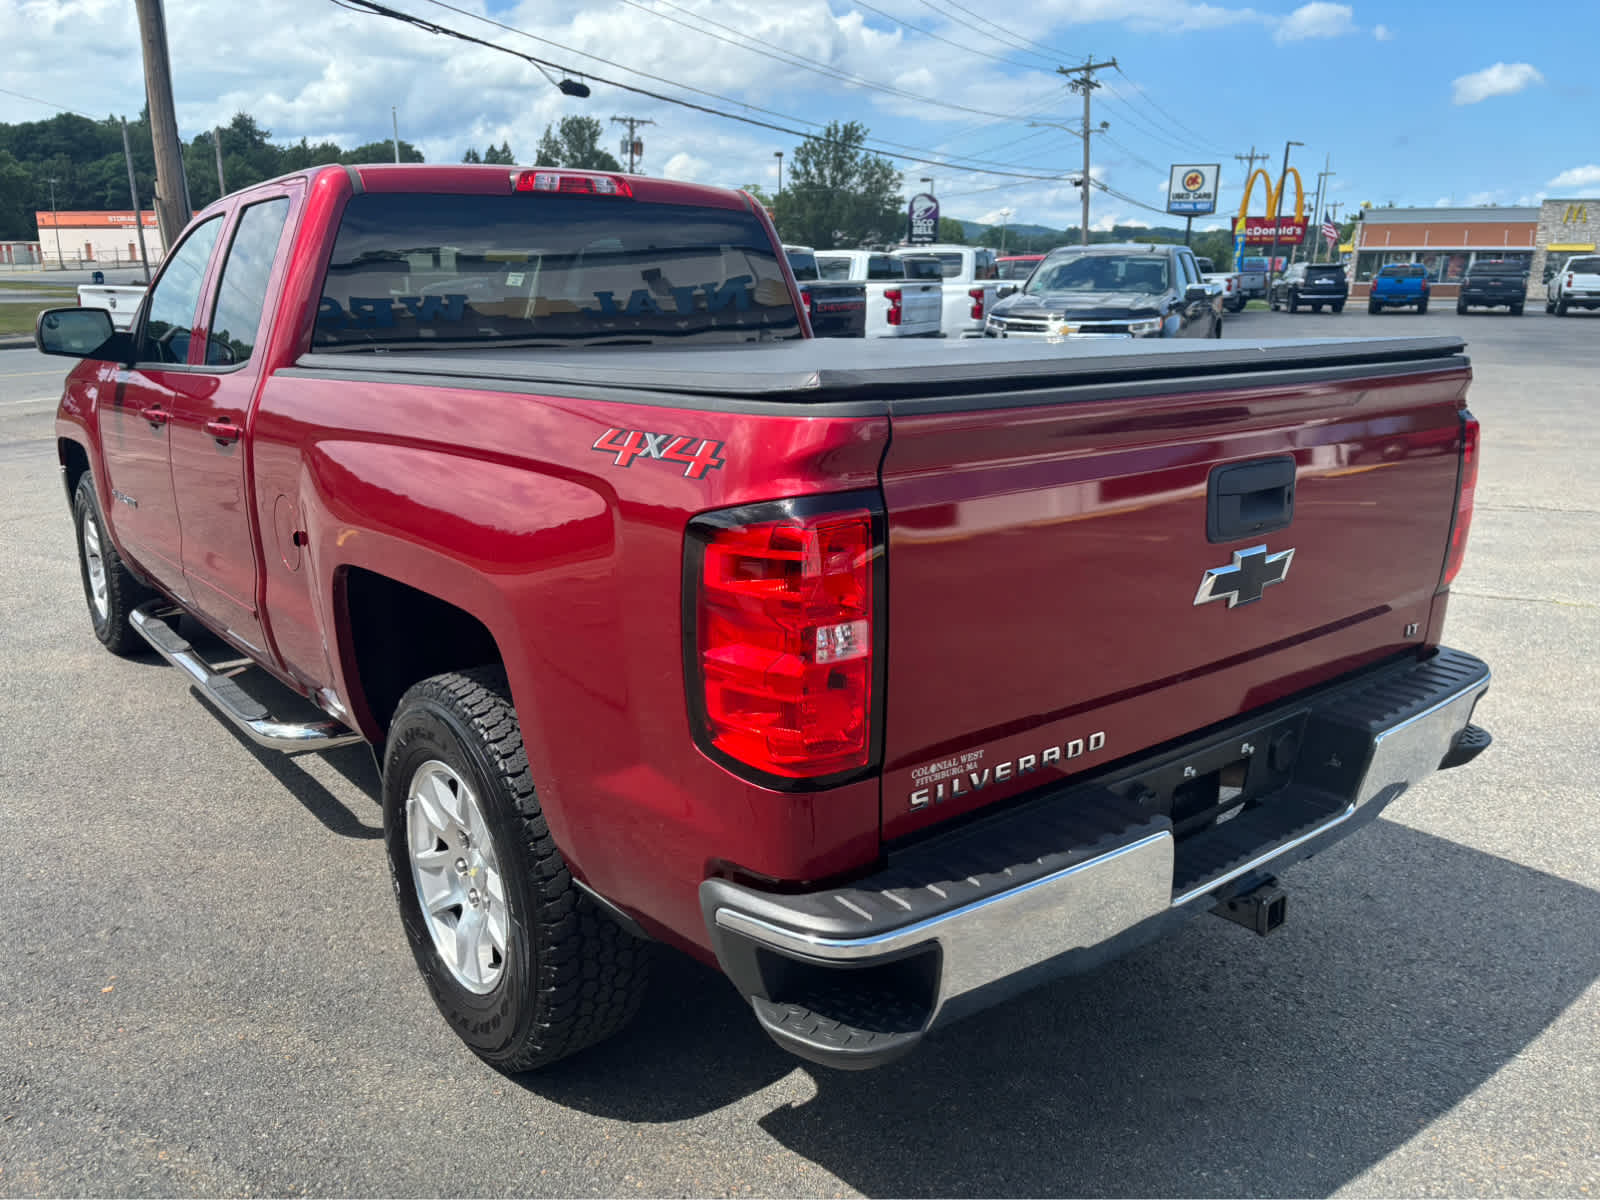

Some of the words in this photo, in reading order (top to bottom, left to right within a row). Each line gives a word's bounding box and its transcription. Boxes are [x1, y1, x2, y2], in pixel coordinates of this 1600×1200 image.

[912, 226, 934, 234] BELL
[1246, 226, 1302, 236] cDonld's
[909, 731, 1107, 811] SILVERADO
[911, 758, 959, 779] COLONIAL
[960, 749, 985, 763] WEST
